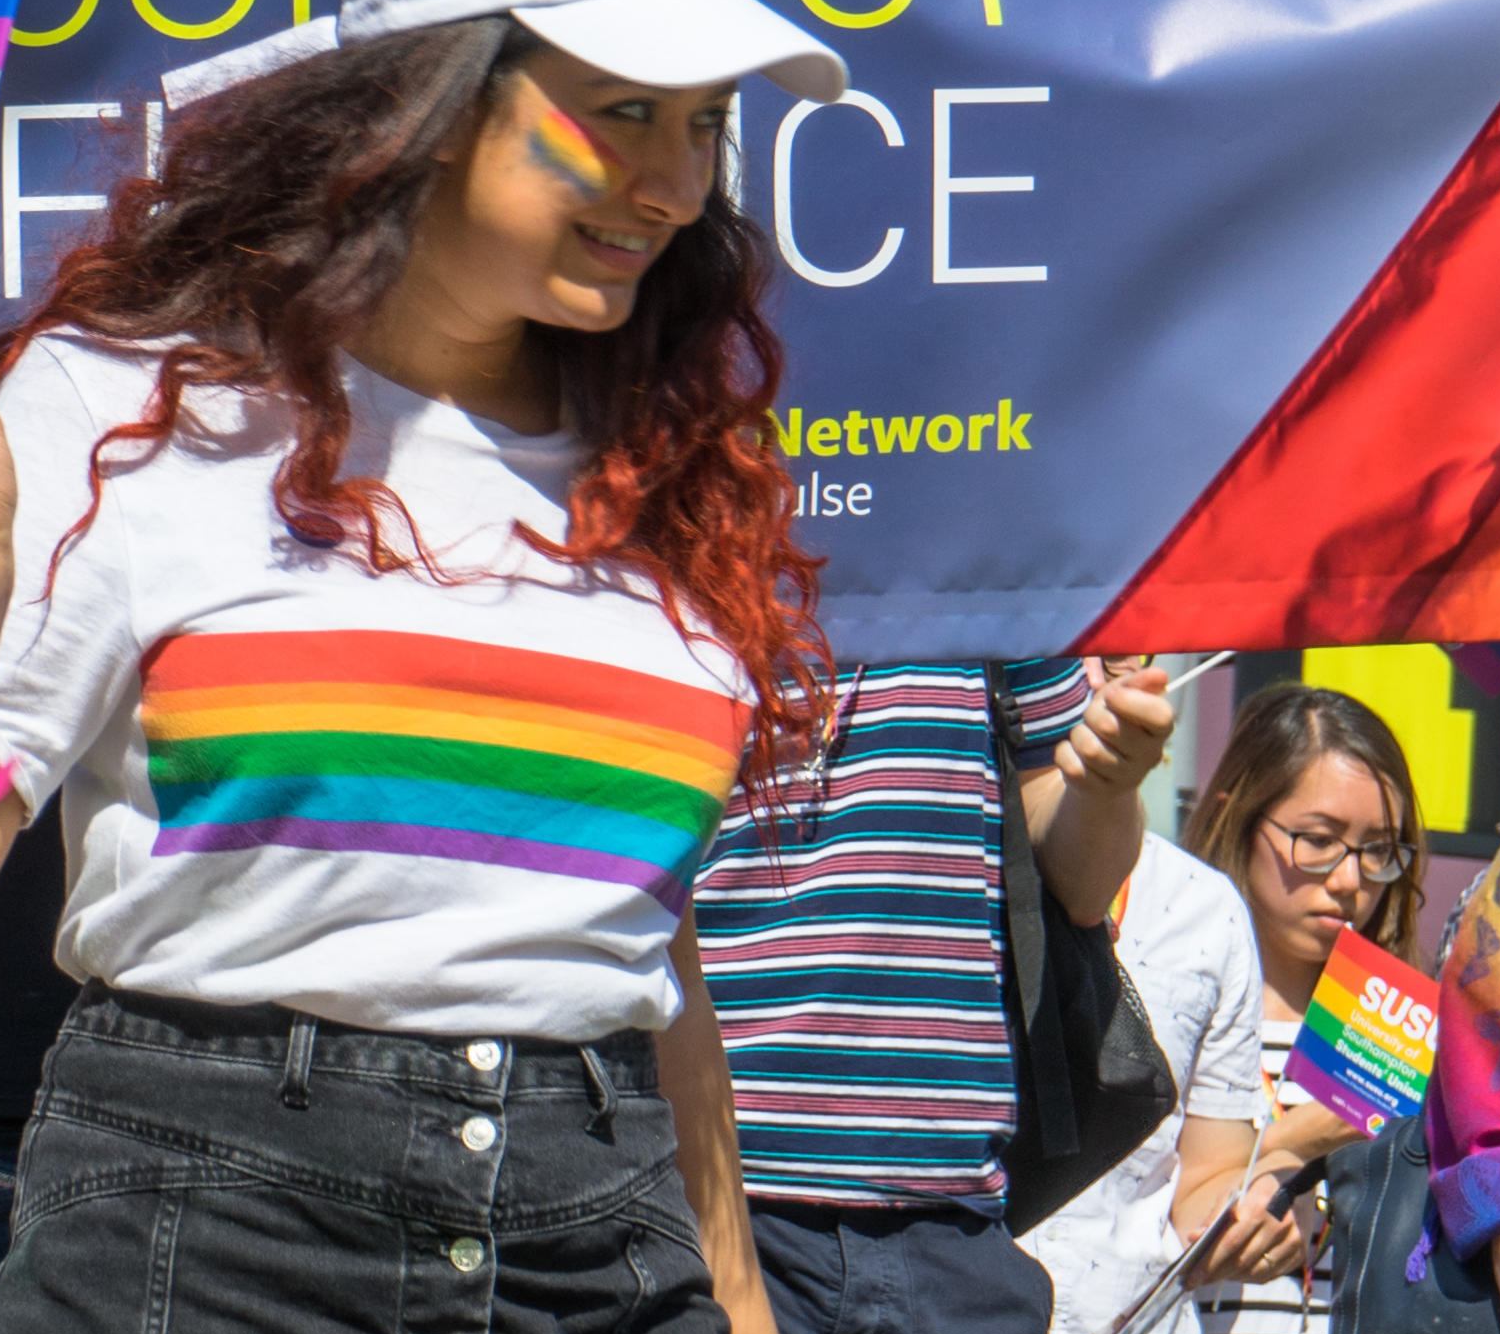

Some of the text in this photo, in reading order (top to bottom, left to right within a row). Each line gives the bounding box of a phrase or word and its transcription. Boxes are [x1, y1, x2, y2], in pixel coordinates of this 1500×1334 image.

[1342, 1023, 1418, 1080] Southampton
[1350, 1009, 1421, 1061] University of
[1387, 1072, 1423, 1103] Union
